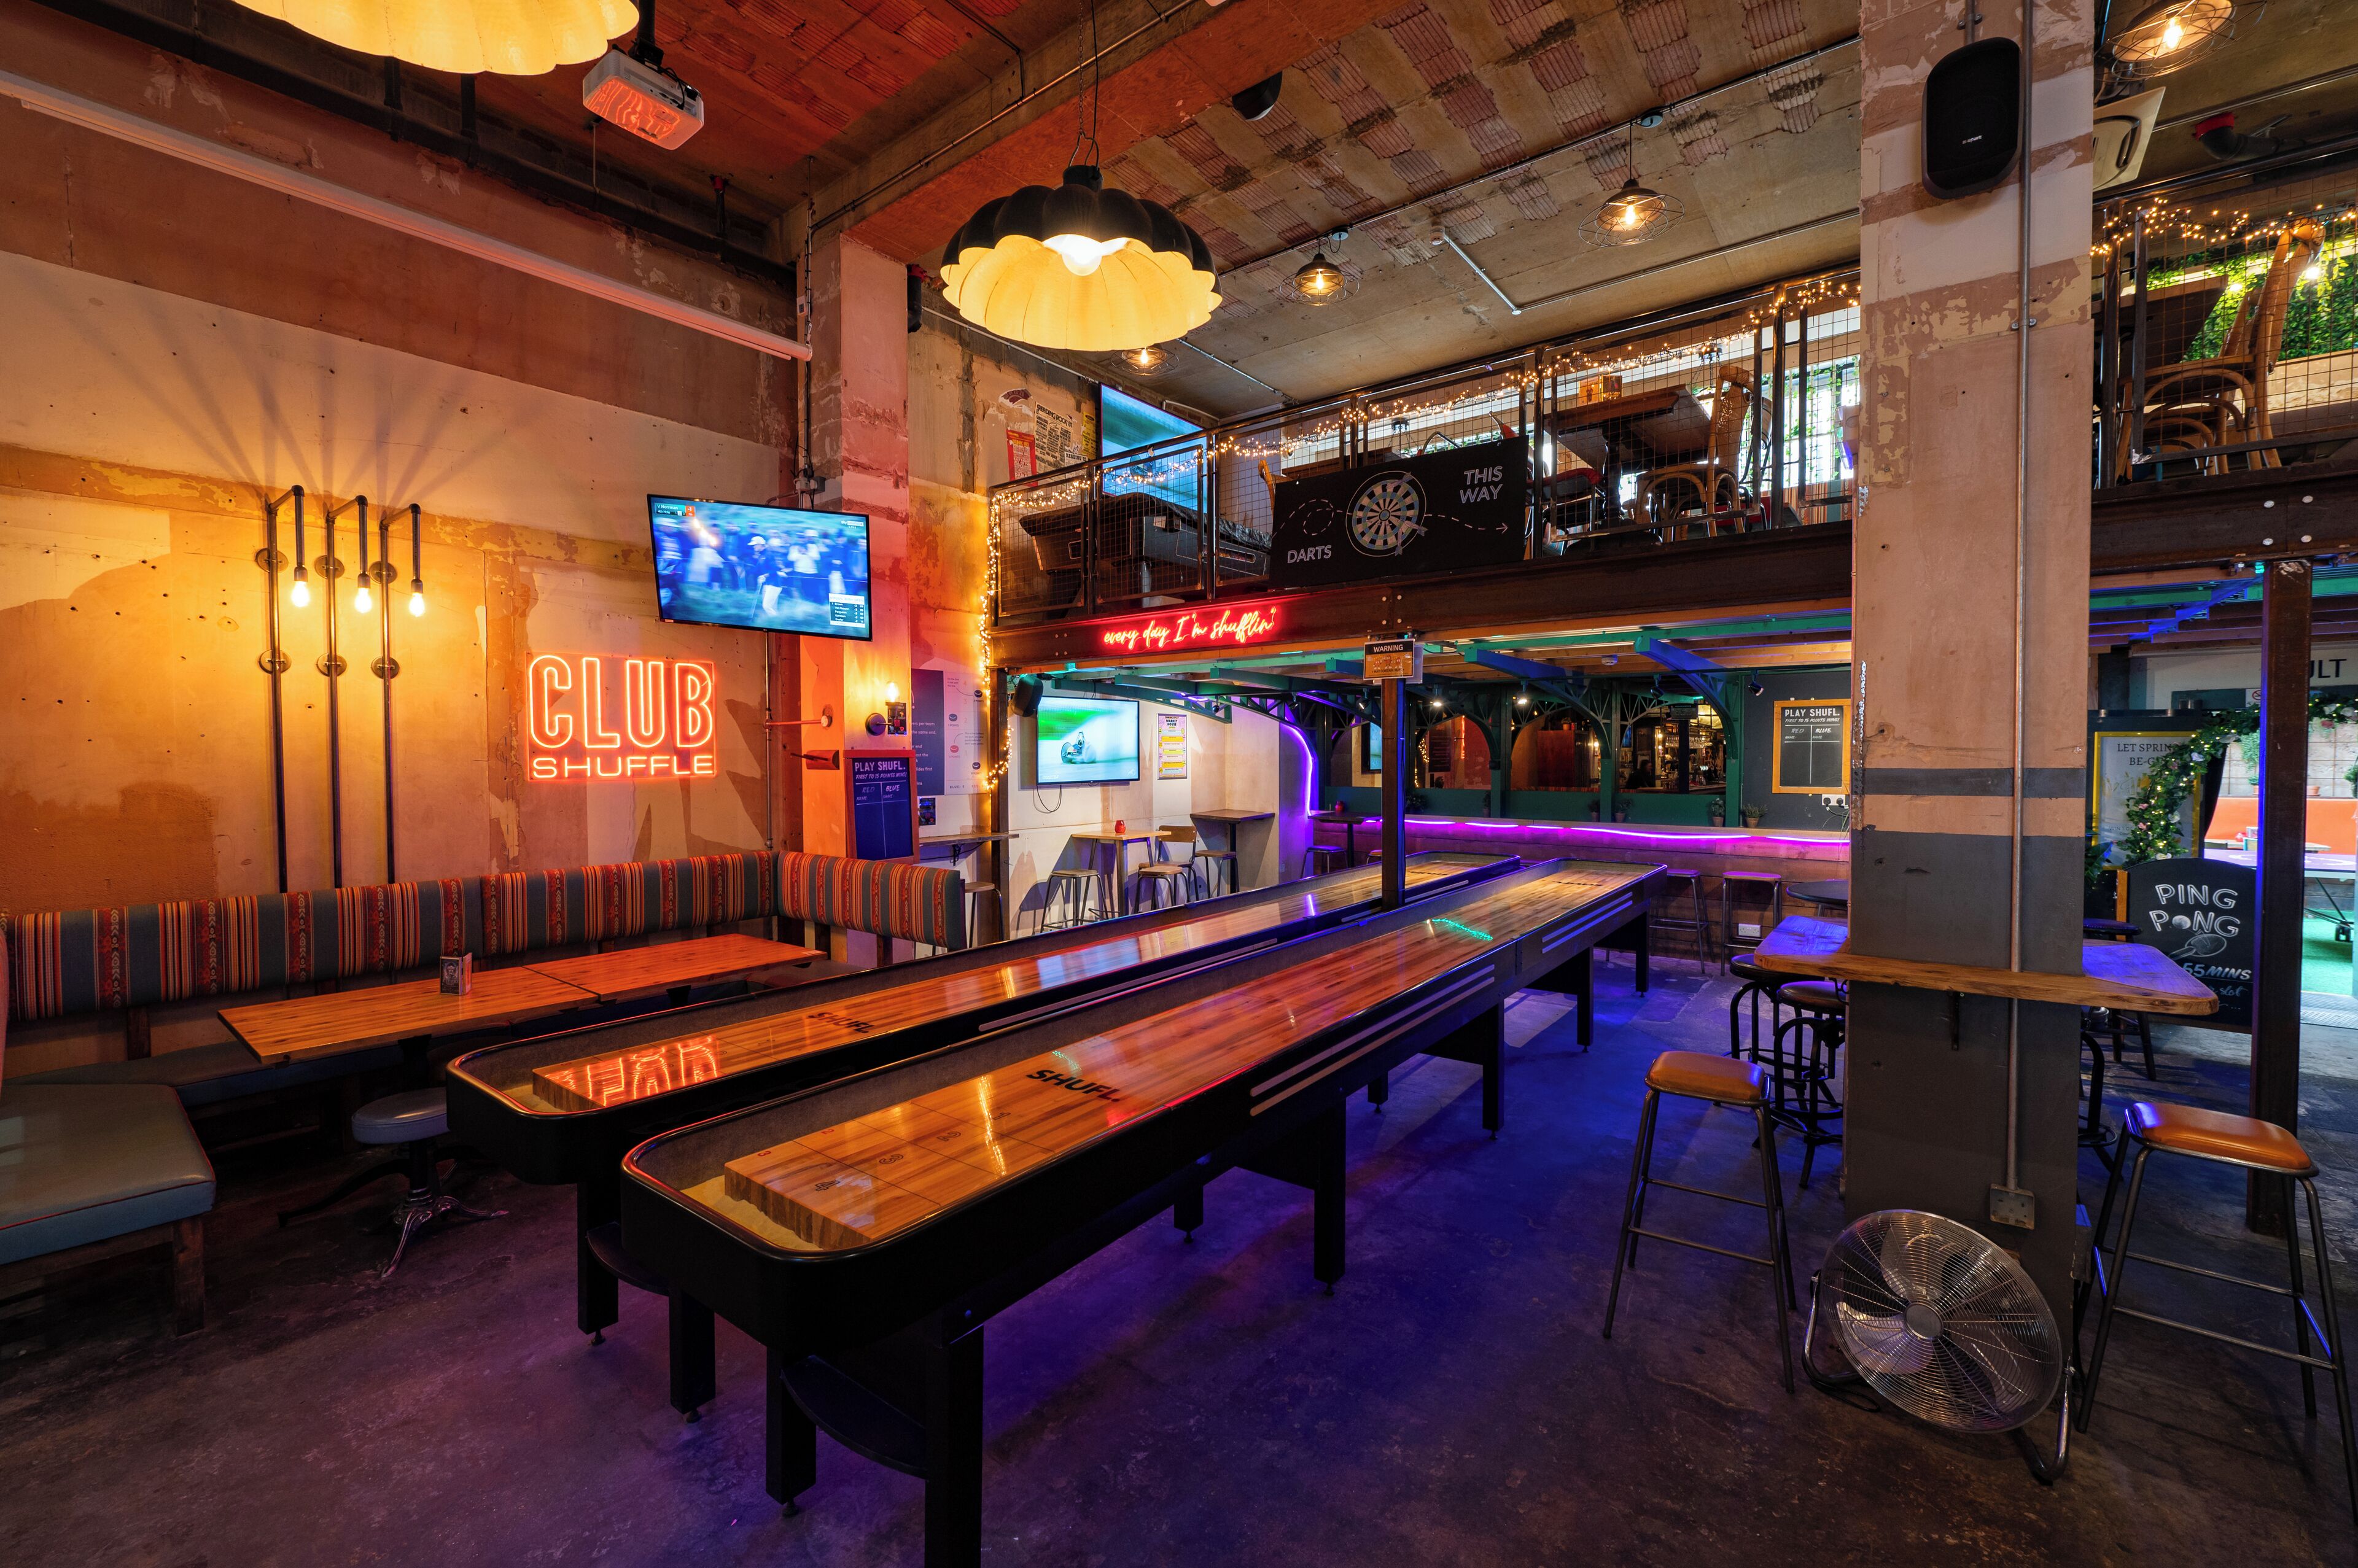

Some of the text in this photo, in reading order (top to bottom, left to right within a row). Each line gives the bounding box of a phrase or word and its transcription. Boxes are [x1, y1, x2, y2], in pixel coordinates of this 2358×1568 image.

[1463, 465, 1503, 485] THIS
[1460, 484, 1503, 504] WAY
[1287, 545, 1332, 564] DARTS
[1103, 630, 1139, 650] every
[1142, 619, 1170, 648] day
[1173, 612, 1207, 642] I'm
[1373, 644, 1404, 653] WARNING
[529, 654, 713, 748] CLUB
[1810, 708, 1840, 716] SHUFL.
[2117, 743, 2172, 752] LET SPRIN
[532, 755, 713, 778] SHUFFLE
[855, 761, 906, 772] PLAY SHUFL.
[2155, 883, 2238, 909] PING
[2149, 910, 2241, 937] PONG
[2206, 966, 2252, 980] MINS
[936, 1131, 962, 1142] 2
[879, 1154, 904, 1165] 3
[814, 1179, 841, 1192] 4
